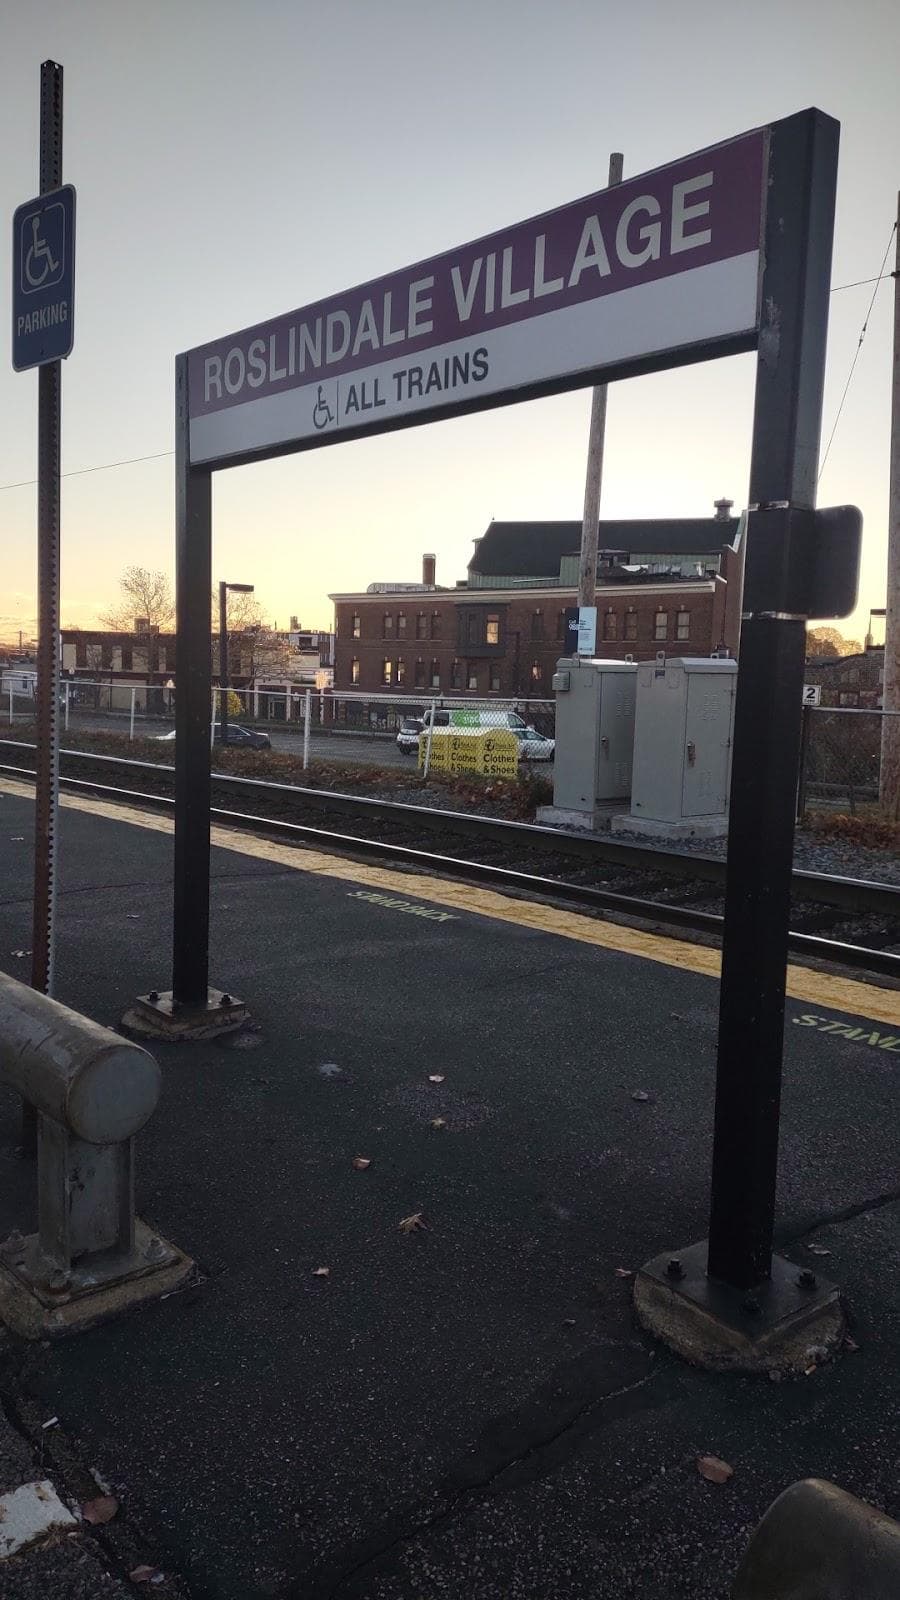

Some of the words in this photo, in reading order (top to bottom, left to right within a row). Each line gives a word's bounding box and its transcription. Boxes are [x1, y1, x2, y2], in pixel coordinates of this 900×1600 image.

[203, 276, 435, 402] ROSLINDALE
[451, 170, 714, 323] VILLAGE
[17, 301, 68, 337] PARKING
[345, 377, 386, 415] ALL
[393, 347, 489, 399] TRAINS
[806, 688, 816, 699] 2
[421, 751, 444, 761] Cthes
[451, 752, 477, 763] Clothes
[483, 754, 515, 763] Clothes
[483, 765, 491, 774] &
[491, 765, 515, 774] Shoes
